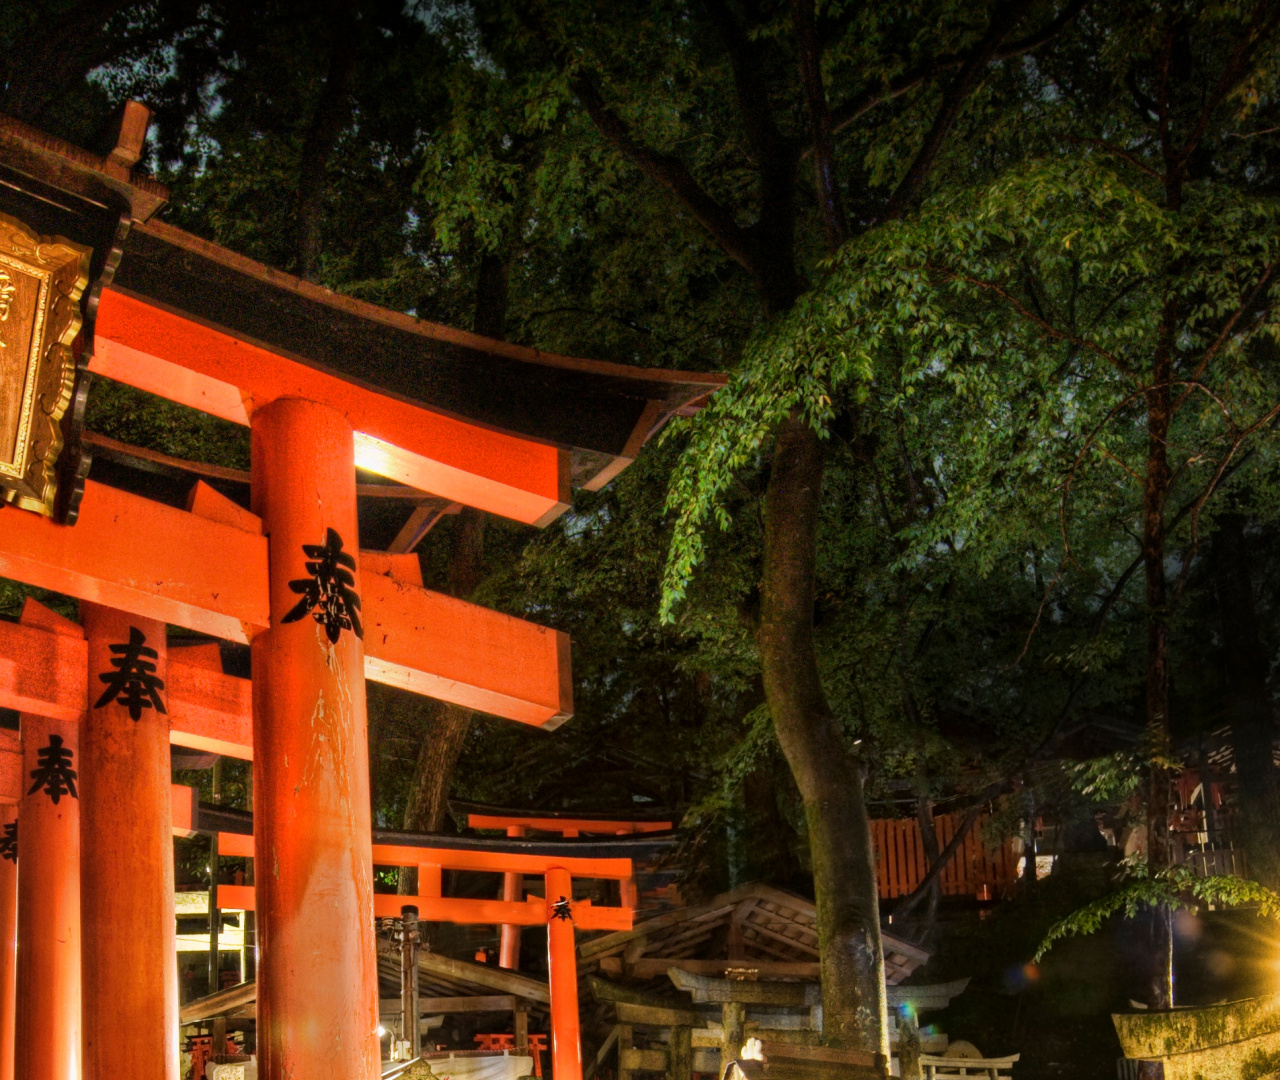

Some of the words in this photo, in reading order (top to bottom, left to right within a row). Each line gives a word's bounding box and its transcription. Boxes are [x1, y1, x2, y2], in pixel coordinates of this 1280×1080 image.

[281, 527, 363, 644] 奉
[94, 626, 167, 721] 奉
[28, 735, 78, 804] 奉
